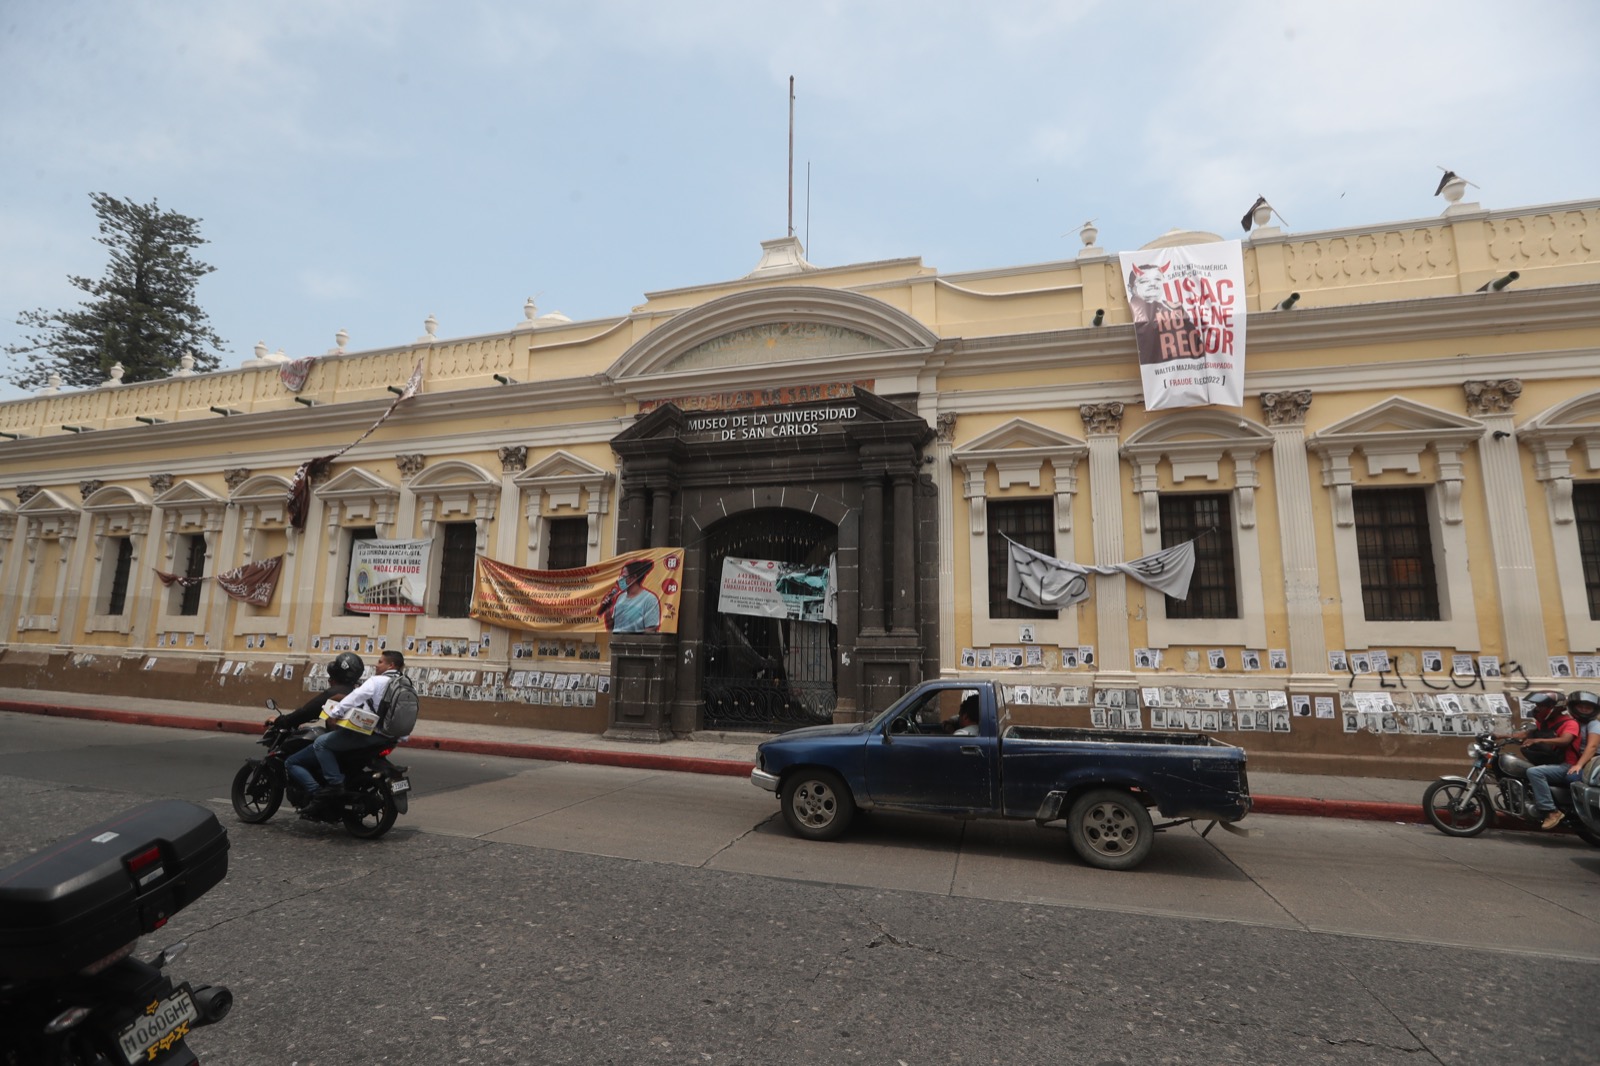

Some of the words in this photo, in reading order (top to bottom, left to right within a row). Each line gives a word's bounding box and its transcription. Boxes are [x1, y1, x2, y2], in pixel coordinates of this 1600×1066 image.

[1162, 277, 1235, 306] USAC
[1155, 309, 1185, 332] NO
[1187, 306, 1234, 328] TENE
[1154, 365, 1175, 375] WALTER
[1169, 377, 1192, 386] FRAUDE
[688, 417, 728, 431] MUSEO
[732, 415, 748, 427] DE
[753, 412, 768, 425] LA
[773, 407, 857, 424] UNIVERSIDAD
[721, 429, 736, 441] DE
[742, 426, 766, 439] SAN
[771, 422, 818, 437] CARLOS
